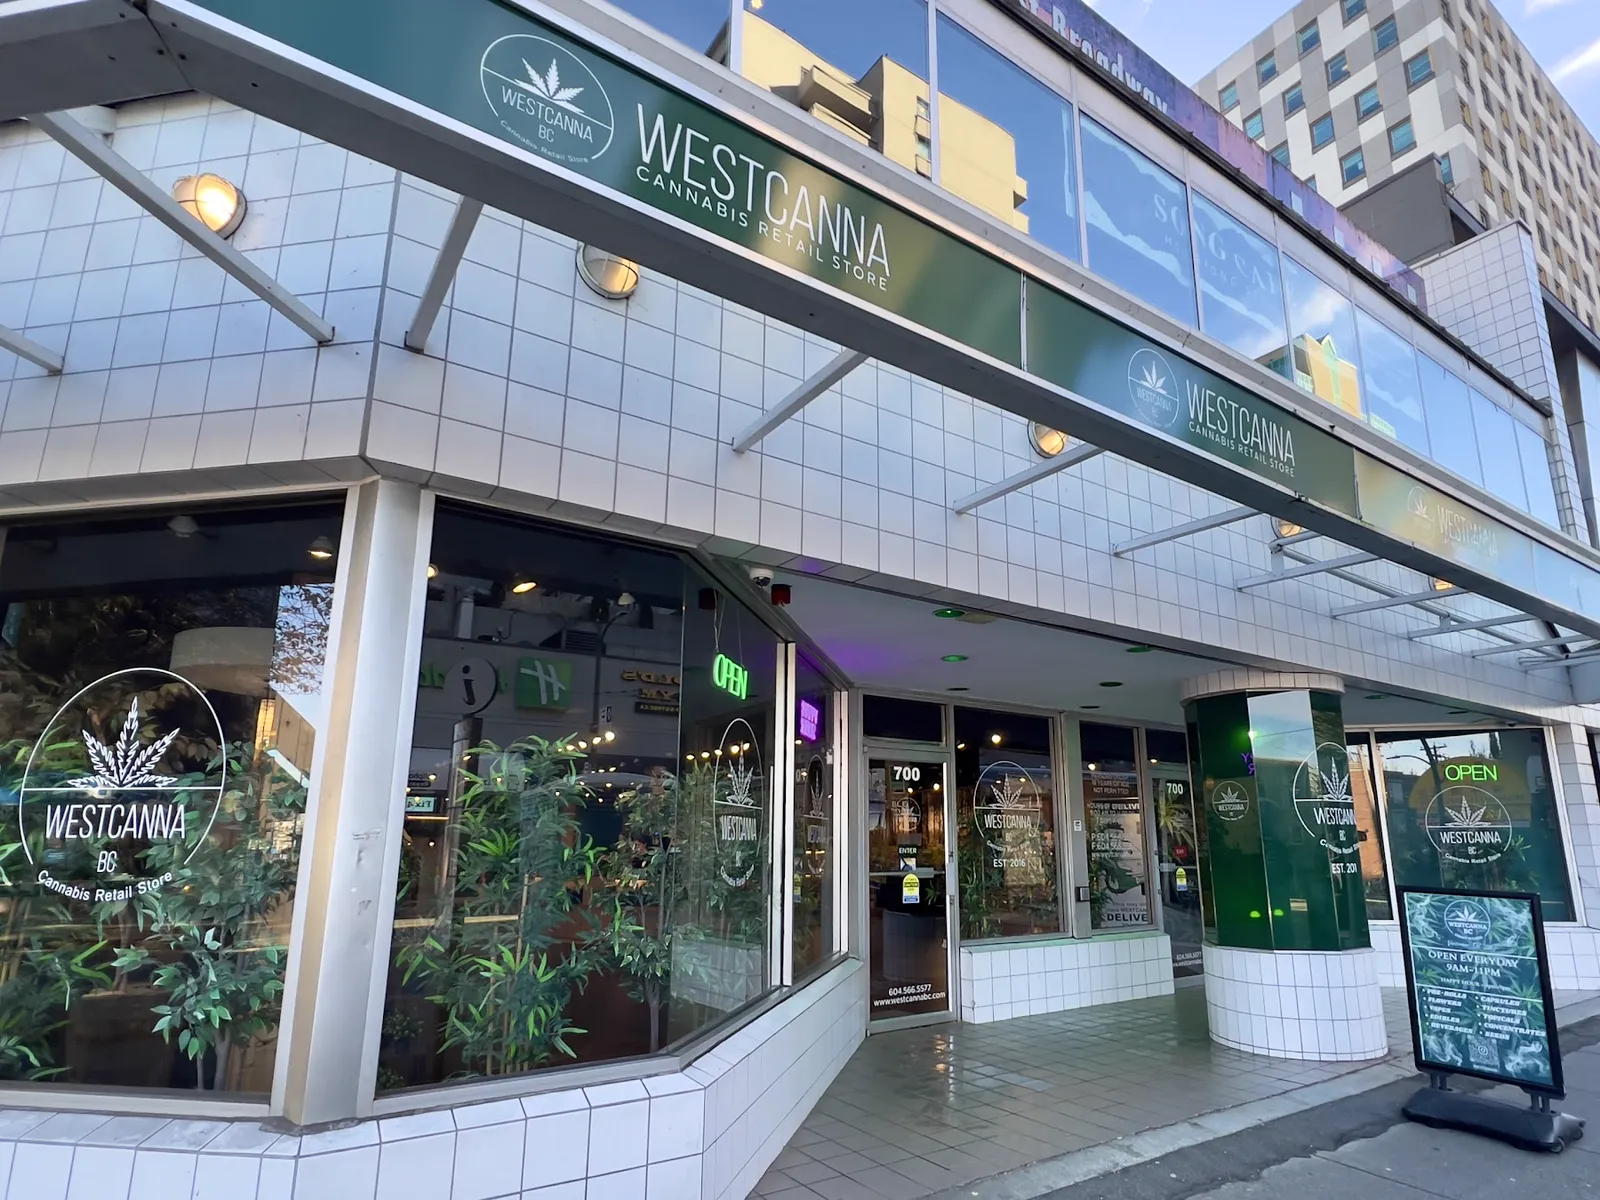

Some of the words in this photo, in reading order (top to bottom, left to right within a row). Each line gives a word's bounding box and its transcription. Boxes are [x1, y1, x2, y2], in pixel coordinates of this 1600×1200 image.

[502, 85, 593, 143] WESTCANNA
[538, 124, 554, 143] BC
[501, 120, 538, 149] Cannabis
[541, 146, 565, 161] Retail
[568, 155, 589, 163] Store
[637, 103, 890, 277] WESTCANNA
[636, 166, 748, 227] CANNABIS
[759, 221, 823, 262] RETAIL
[832, 255, 887, 292] STORE
[1186, 379, 1295, 467] WESTCANNA
[1189, 421, 1235, 450] CANNABIS
[1238, 443, 1267, 465] RETAIL
[1270, 459, 1295, 477] STORE
[713, 653, 748, 700] OPEN
[893, 766, 921, 781] 700
[1445, 764, 1498, 781] OPEN
[1166, 783, 1184, 795] 700
[45, 804, 186, 839] WESTCANNA
[984, 814, 1032, 829] WESTCANNA
[1440, 831, 1501, 844] WESTCANNA
[1467, 846, 1477, 855] BC
[97, 850, 118, 873] BC
[37, 870, 91, 902] Cannabis
[95, 887, 133, 902] Retail
[137, 872, 173, 894] Store
[1107, 913, 1147, 922] DELIVE
[1448, 921, 1488, 930] WESTCANNA
[1428, 950, 1458, 961] OPEN
[1460, 954, 1519, 968] EVERYDAY
[1446, 963, 1501, 977] 9AM-11PM
[888, 983, 932, 996] 604.566.5577
[873, 991, 946, 1007] www.westcannabc.com
[1428, 996, 1462, 1007] FLOWERS
[1480, 996, 1520, 1006] CAPSULES
[1429, 1005, 1451, 1014] VAPES
[1482, 1005, 1527, 1016] TINCTURES
[1430, 1014, 1460, 1023] EDIBLES
[1483, 1014, 1520, 1024] TOPICALS
[1431, 1023, 1473, 1034] BEVERAGES
[1484, 1023, 1546, 1037] CONCENTRATES
[1485, 1032, 1510, 1040] SEEDS
